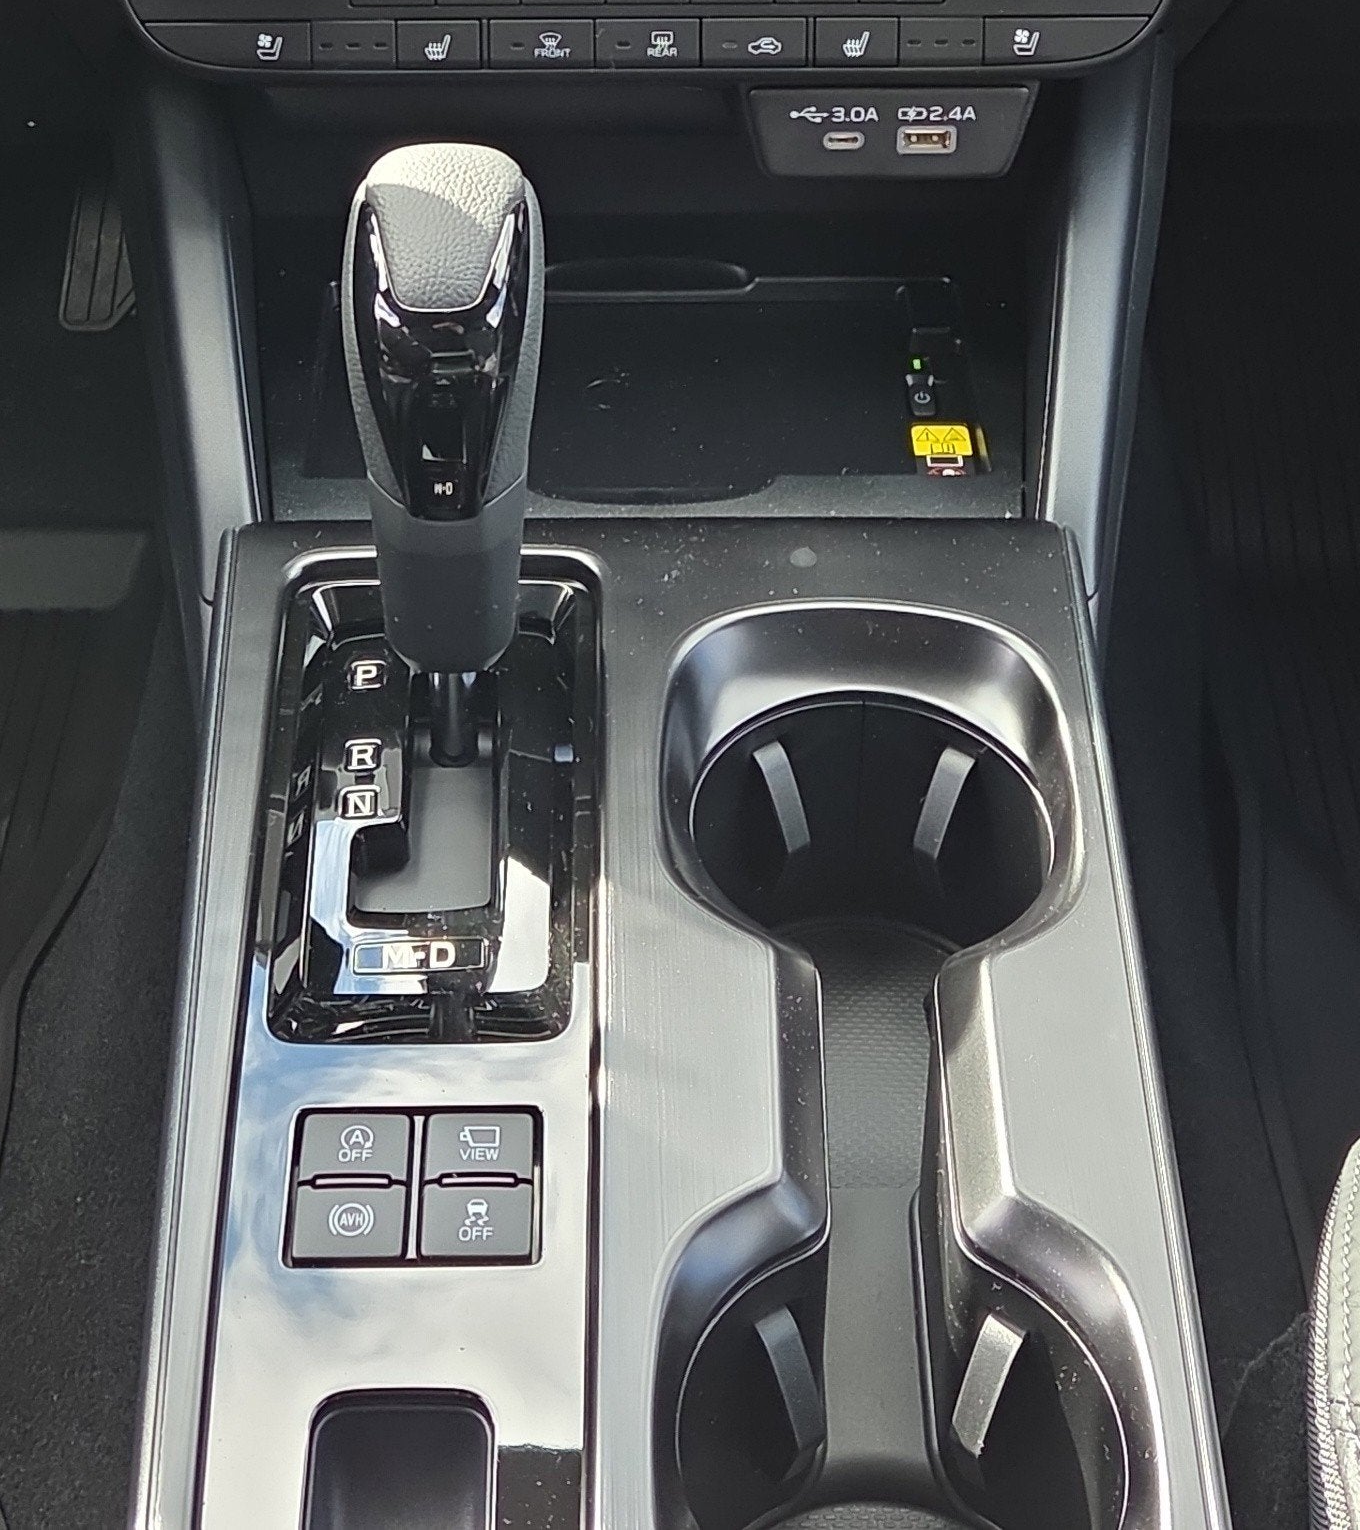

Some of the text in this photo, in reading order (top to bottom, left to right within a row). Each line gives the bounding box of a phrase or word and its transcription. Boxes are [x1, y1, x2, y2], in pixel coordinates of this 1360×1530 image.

[534, 48, 571, 58] FRONT
[646, 47, 677, 58] REAR
[832, 106, 878, 123] 3.0A
[928, 106, 976, 122] 2.4A
[357, 665, 377, 686] P
[350, 746, 374, 768] R
[348, 797, 373, 817] N
[339, 1149, 373, 1162] OFF
[459, 1148, 500, 1161] VIEW
[340, 1213, 363, 1226] AVH
[459, 1227, 493, 1241] OFF
